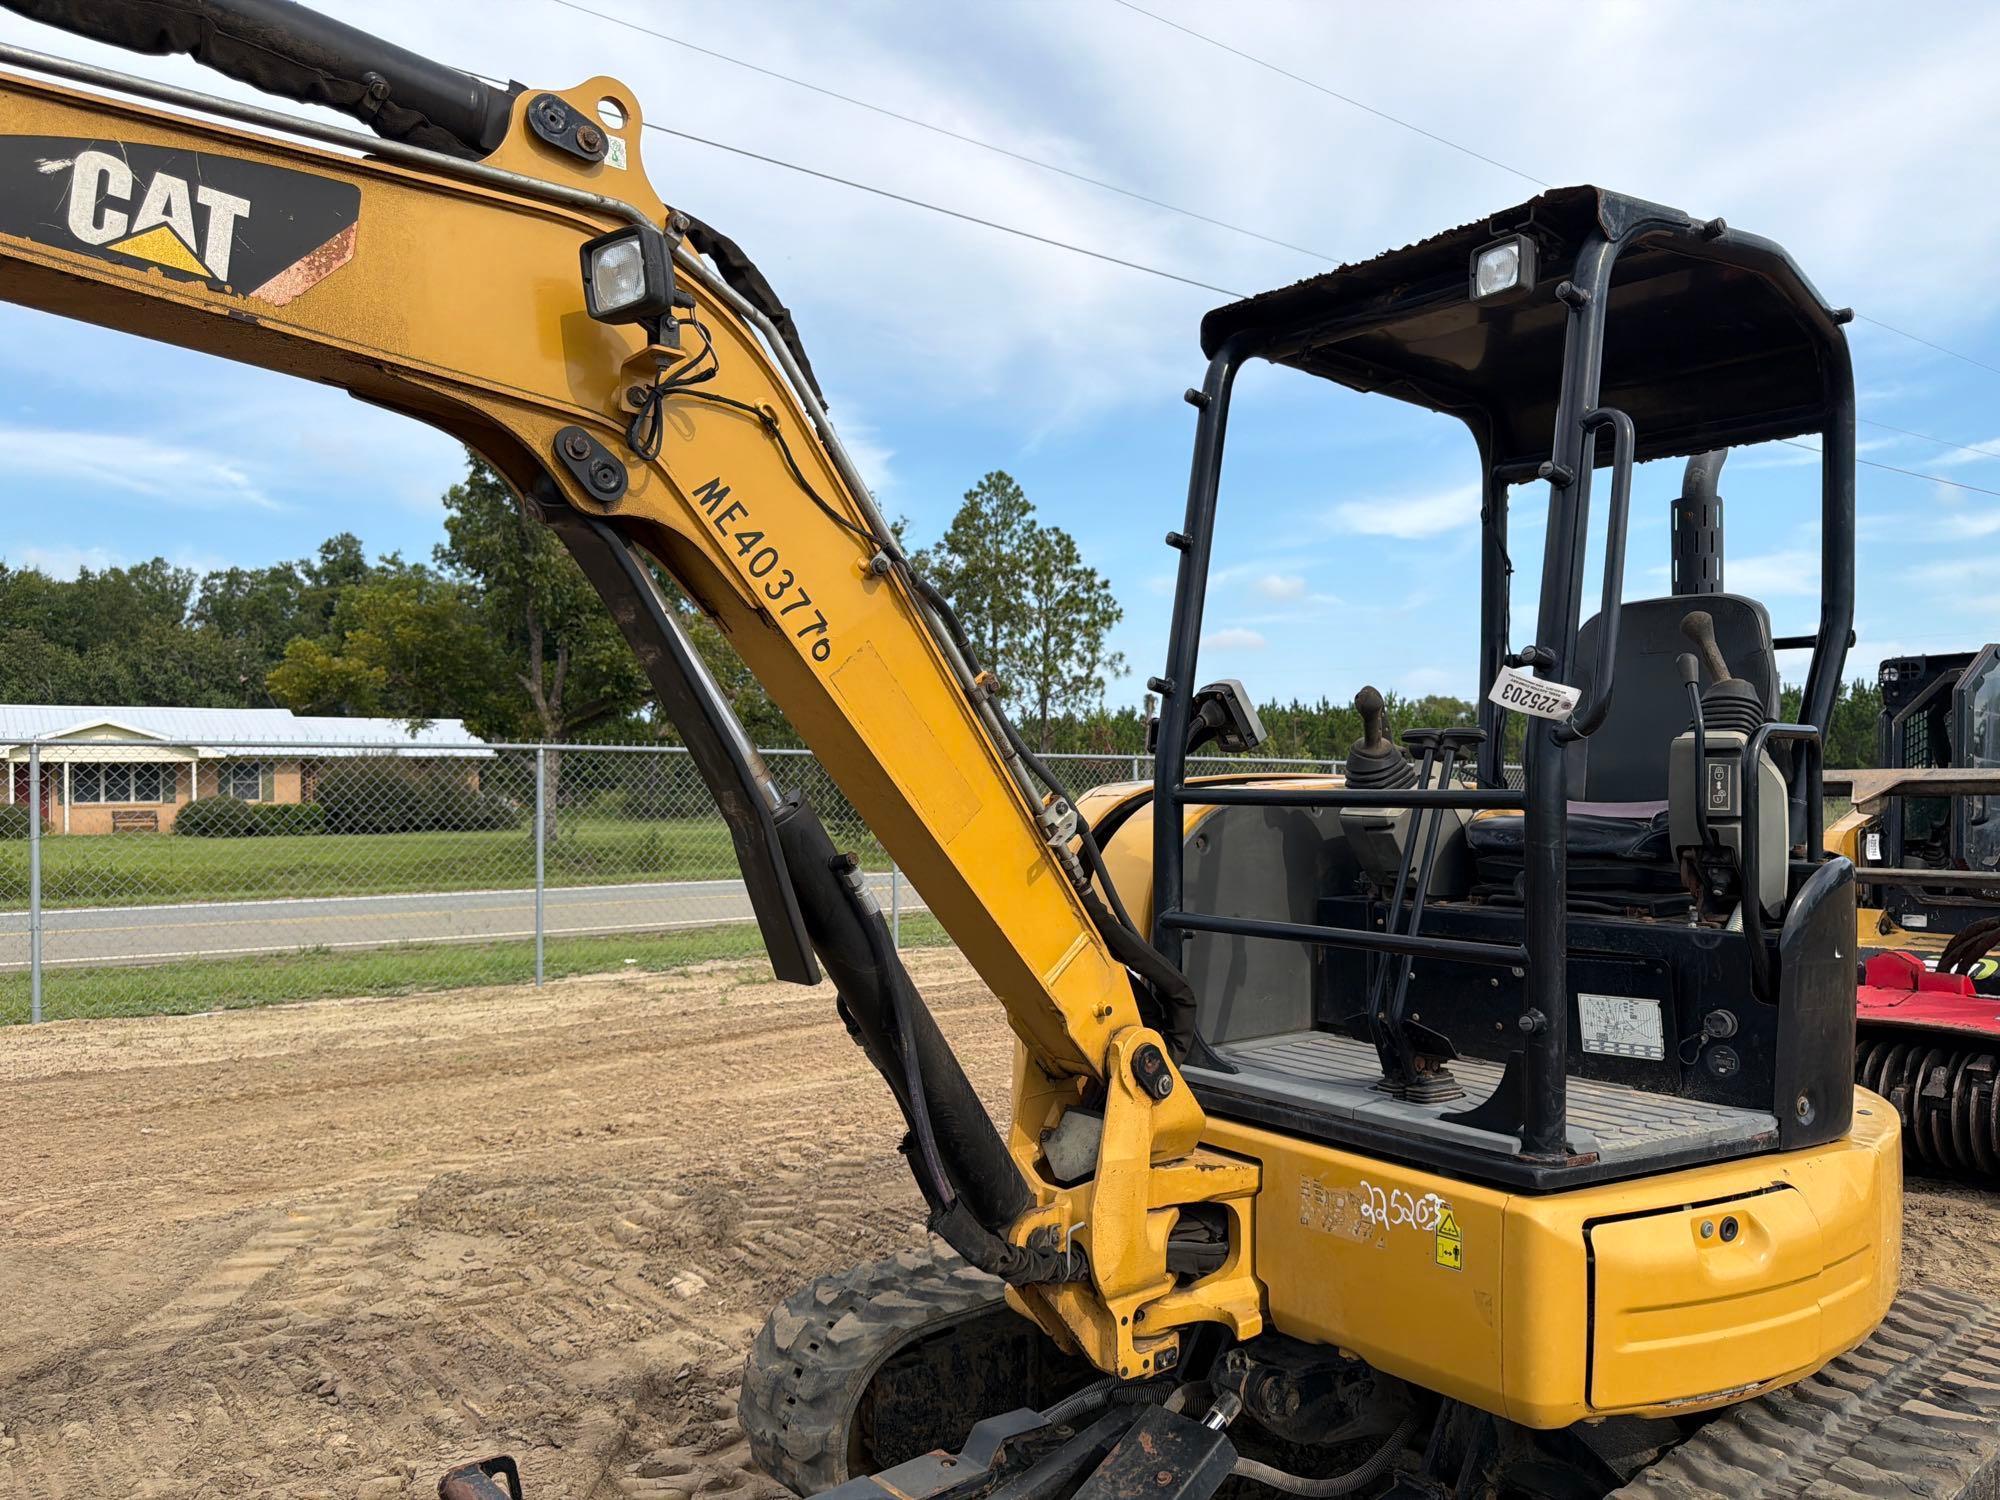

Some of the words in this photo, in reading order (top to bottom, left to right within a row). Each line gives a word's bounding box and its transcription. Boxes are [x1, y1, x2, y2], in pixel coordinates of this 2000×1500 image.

[68, 150, 251, 282] CAT
[1502, 684, 1561, 713] 225203
[1360, 1180, 1444, 1231] 225203
